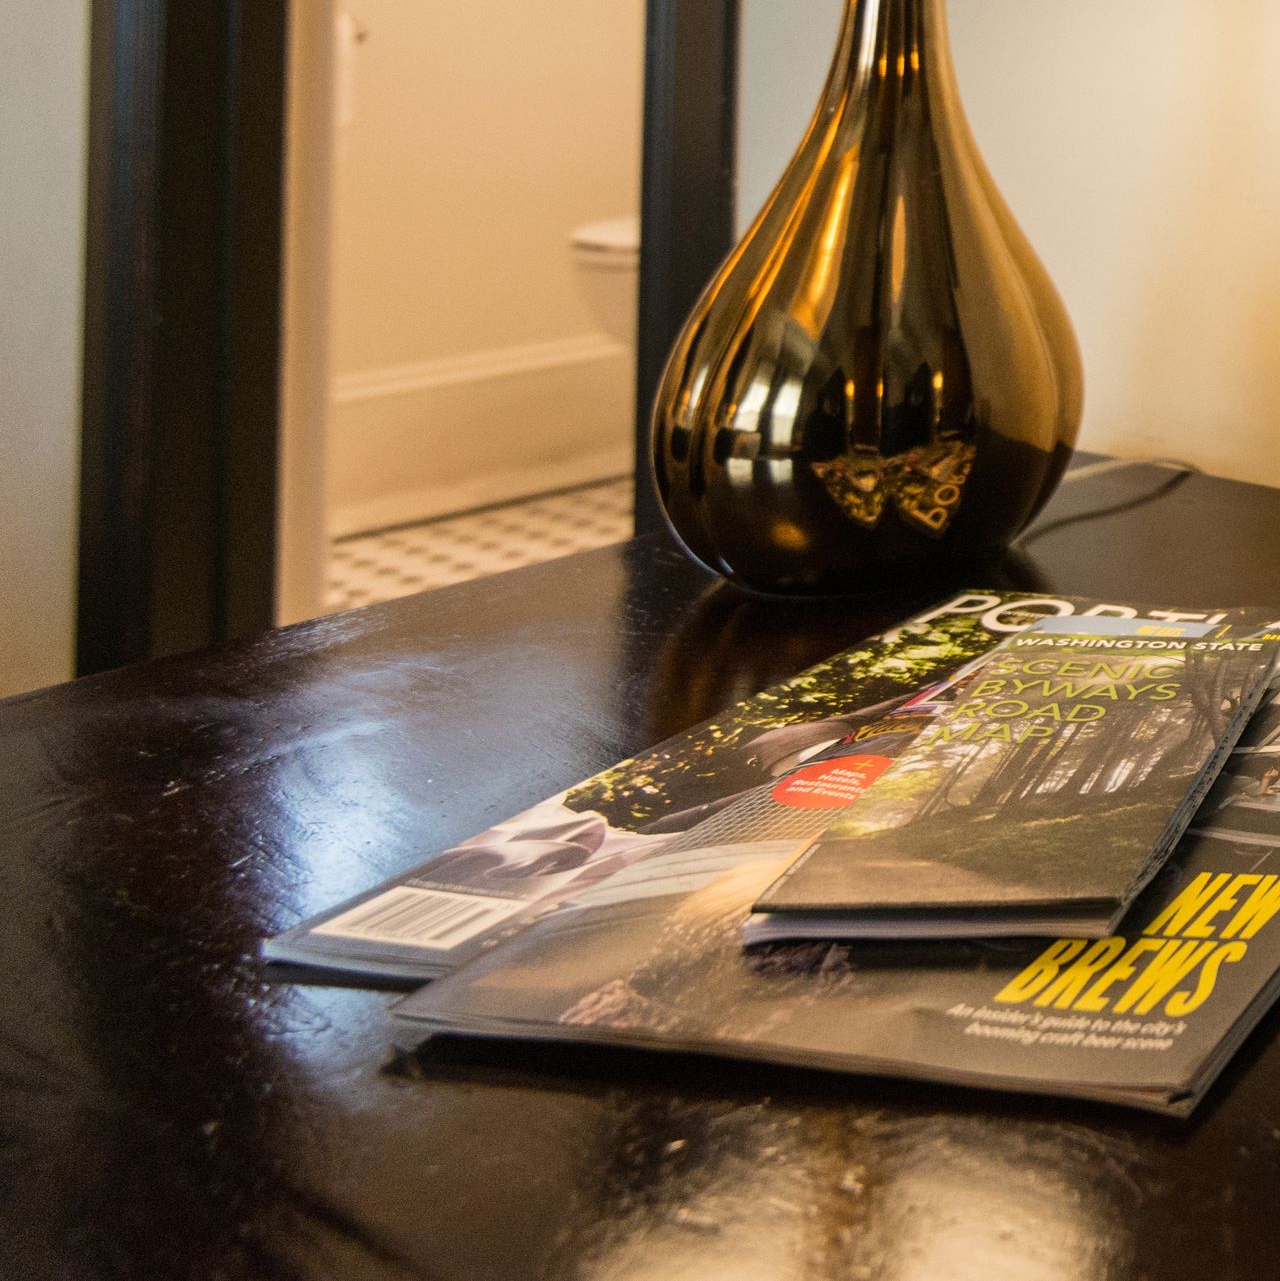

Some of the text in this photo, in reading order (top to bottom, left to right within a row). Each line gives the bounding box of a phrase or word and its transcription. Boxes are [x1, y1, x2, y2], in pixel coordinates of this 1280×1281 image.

[1016, 637, 1265, 652] WASHINGTON STATE
[989, 658, 1177, 680] SCENIC
[969, 678, 1182, 702] BYWAYS
[949, 699, 1107, 722] ROAD
[923, 722, 1056, 747] MAP
[818, 774, 861, 786] Hotels,
[830, 768, 867, 780] Maps,
[813, 787, 857, 800] Events
[994, 936, 1248, 1017] BREWS
